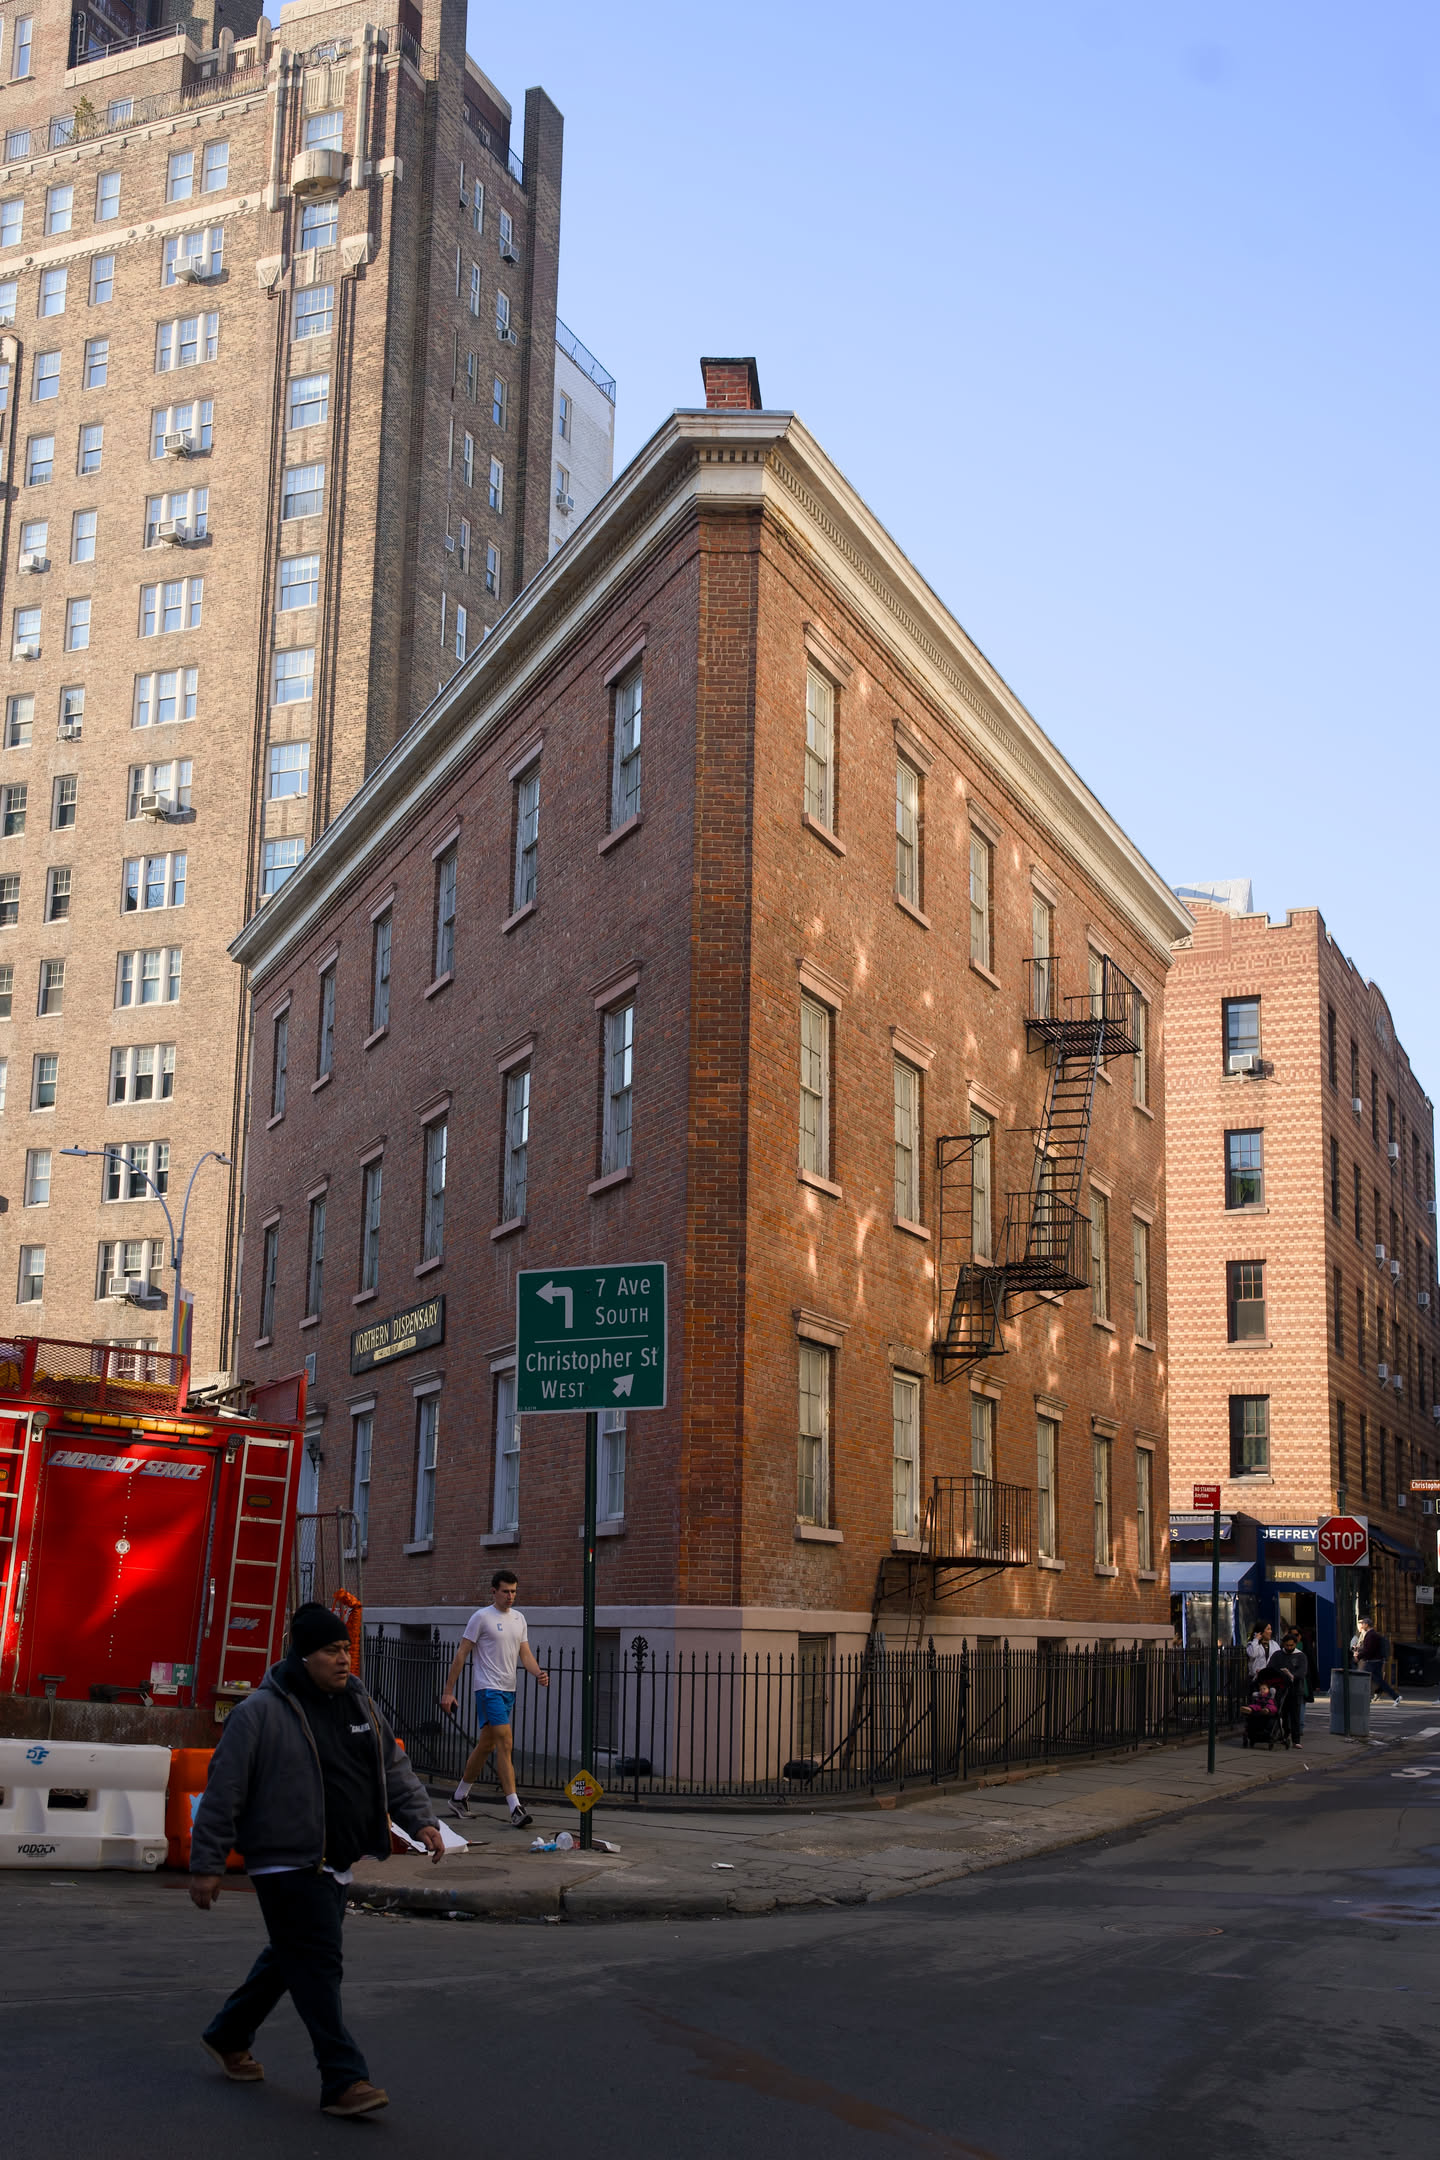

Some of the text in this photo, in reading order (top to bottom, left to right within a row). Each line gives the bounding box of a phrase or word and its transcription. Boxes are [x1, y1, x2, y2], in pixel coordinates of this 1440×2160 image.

[595, 1277, 651, 1297] 7 Ave
[595, 1306, 649, 1325] SOUTH
[355, 1323, 389, 1356] NORTHERN
[393, 1301, 439, 1340] DISPENSARY
[526, 1347, 658, 1375] Christopher St
[541, 1380, 585, 1399] WEST
[47, 1450, 206, 1480] EMERGENCY SERVICE
[1321, 1532, 1364, 1550] STOP
[17, 1843, 56, 1854] YODOCK
